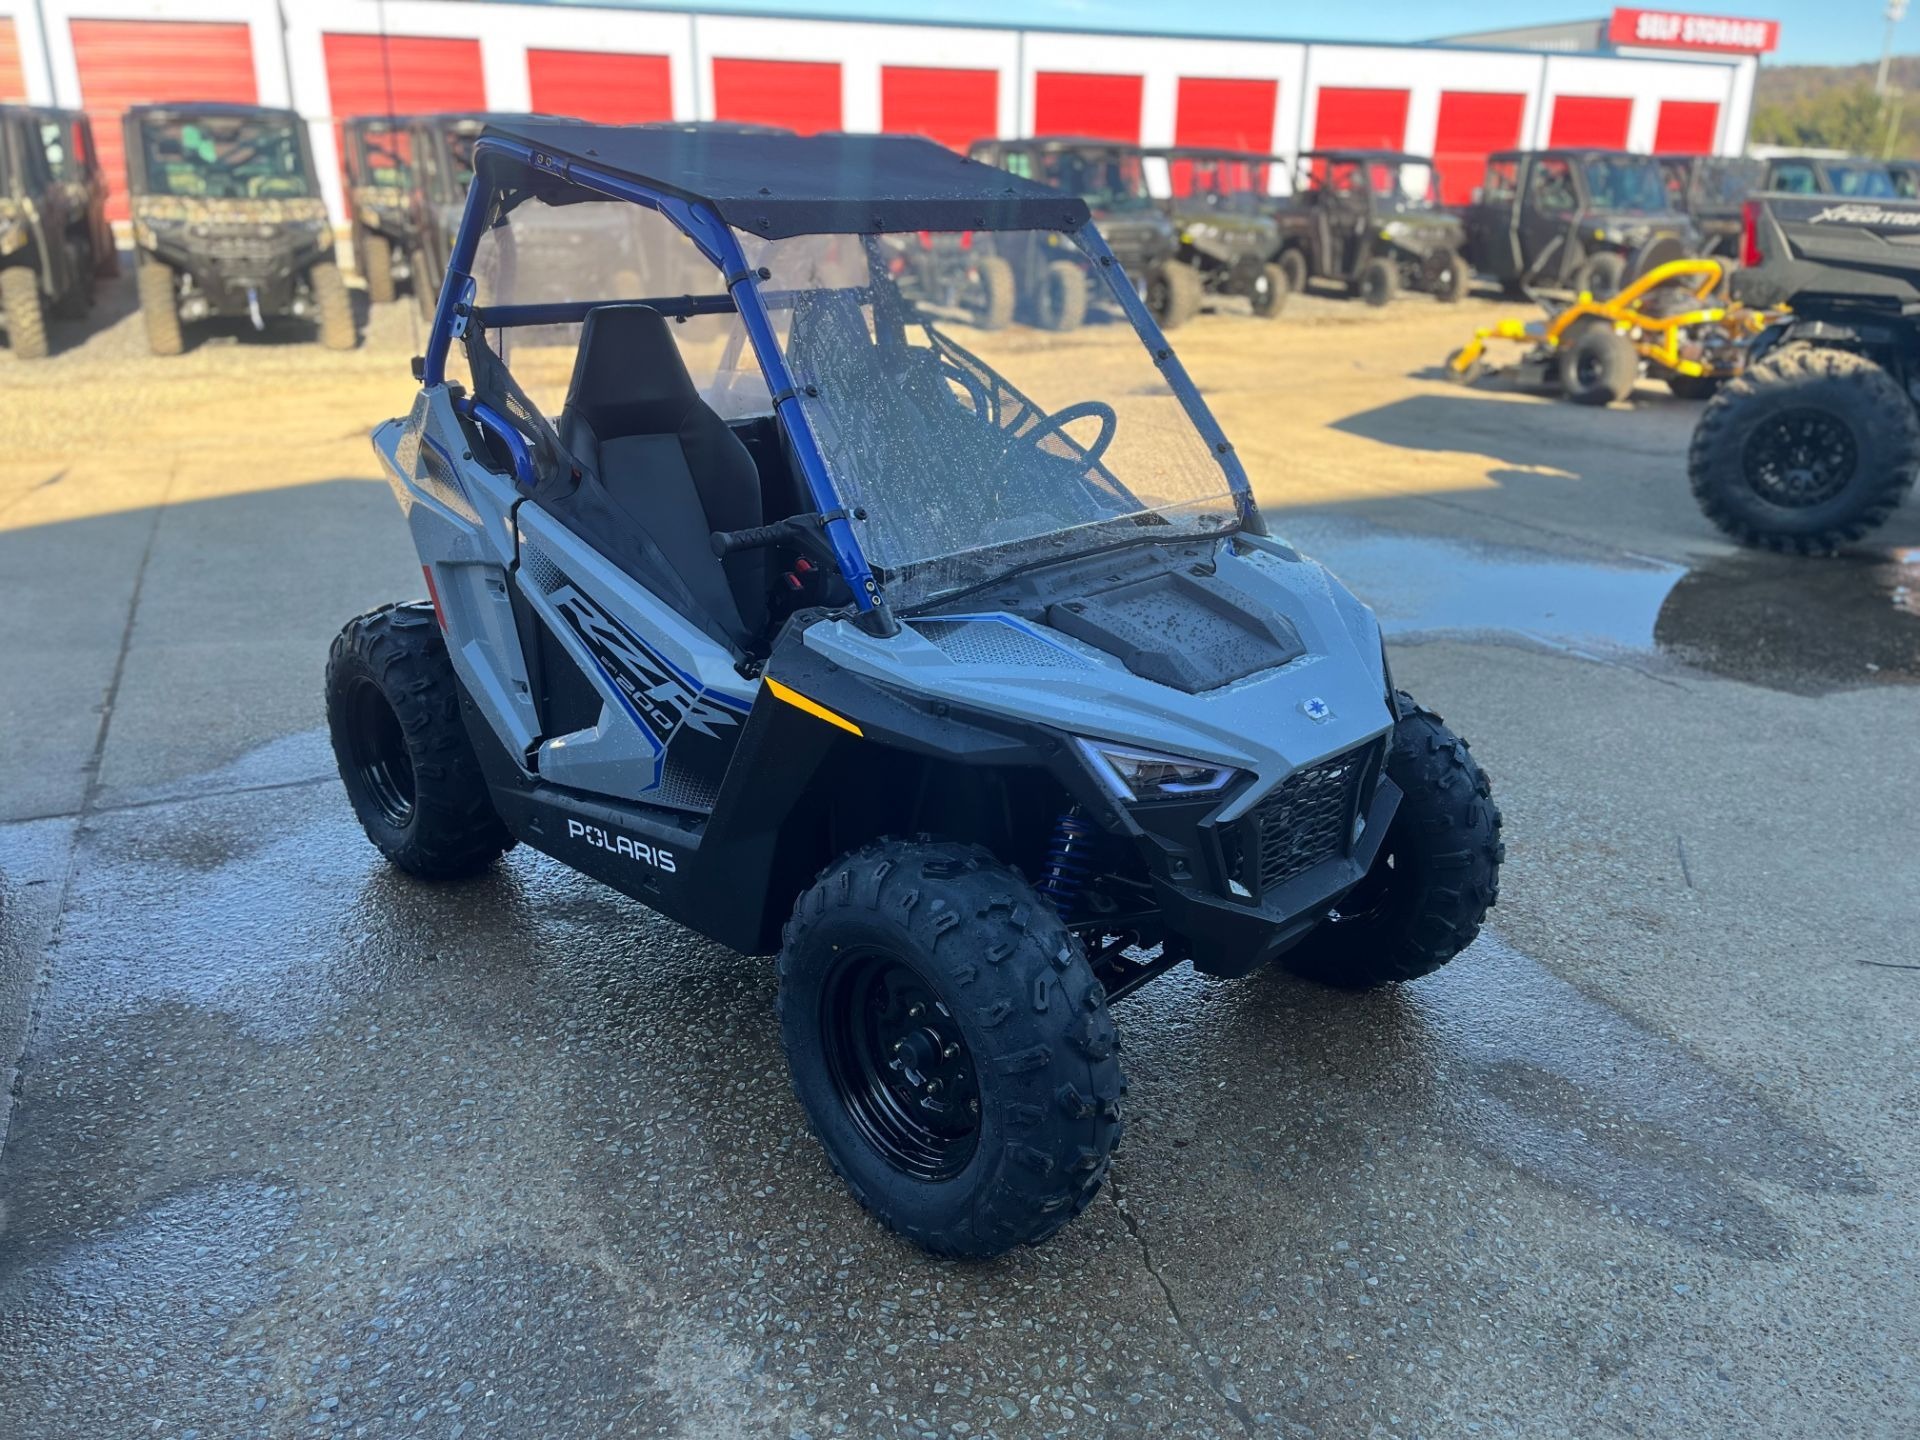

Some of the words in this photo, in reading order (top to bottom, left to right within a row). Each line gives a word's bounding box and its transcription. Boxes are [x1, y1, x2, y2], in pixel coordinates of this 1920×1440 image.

[1636, 12, 1681, 40] SELF
[1681, 16, 1767, 48] STORAGE
[548, 585, 740, 740] RZR
[616, 673, 674, 730] 200
[567, 818, 676, 873] POLARIS
